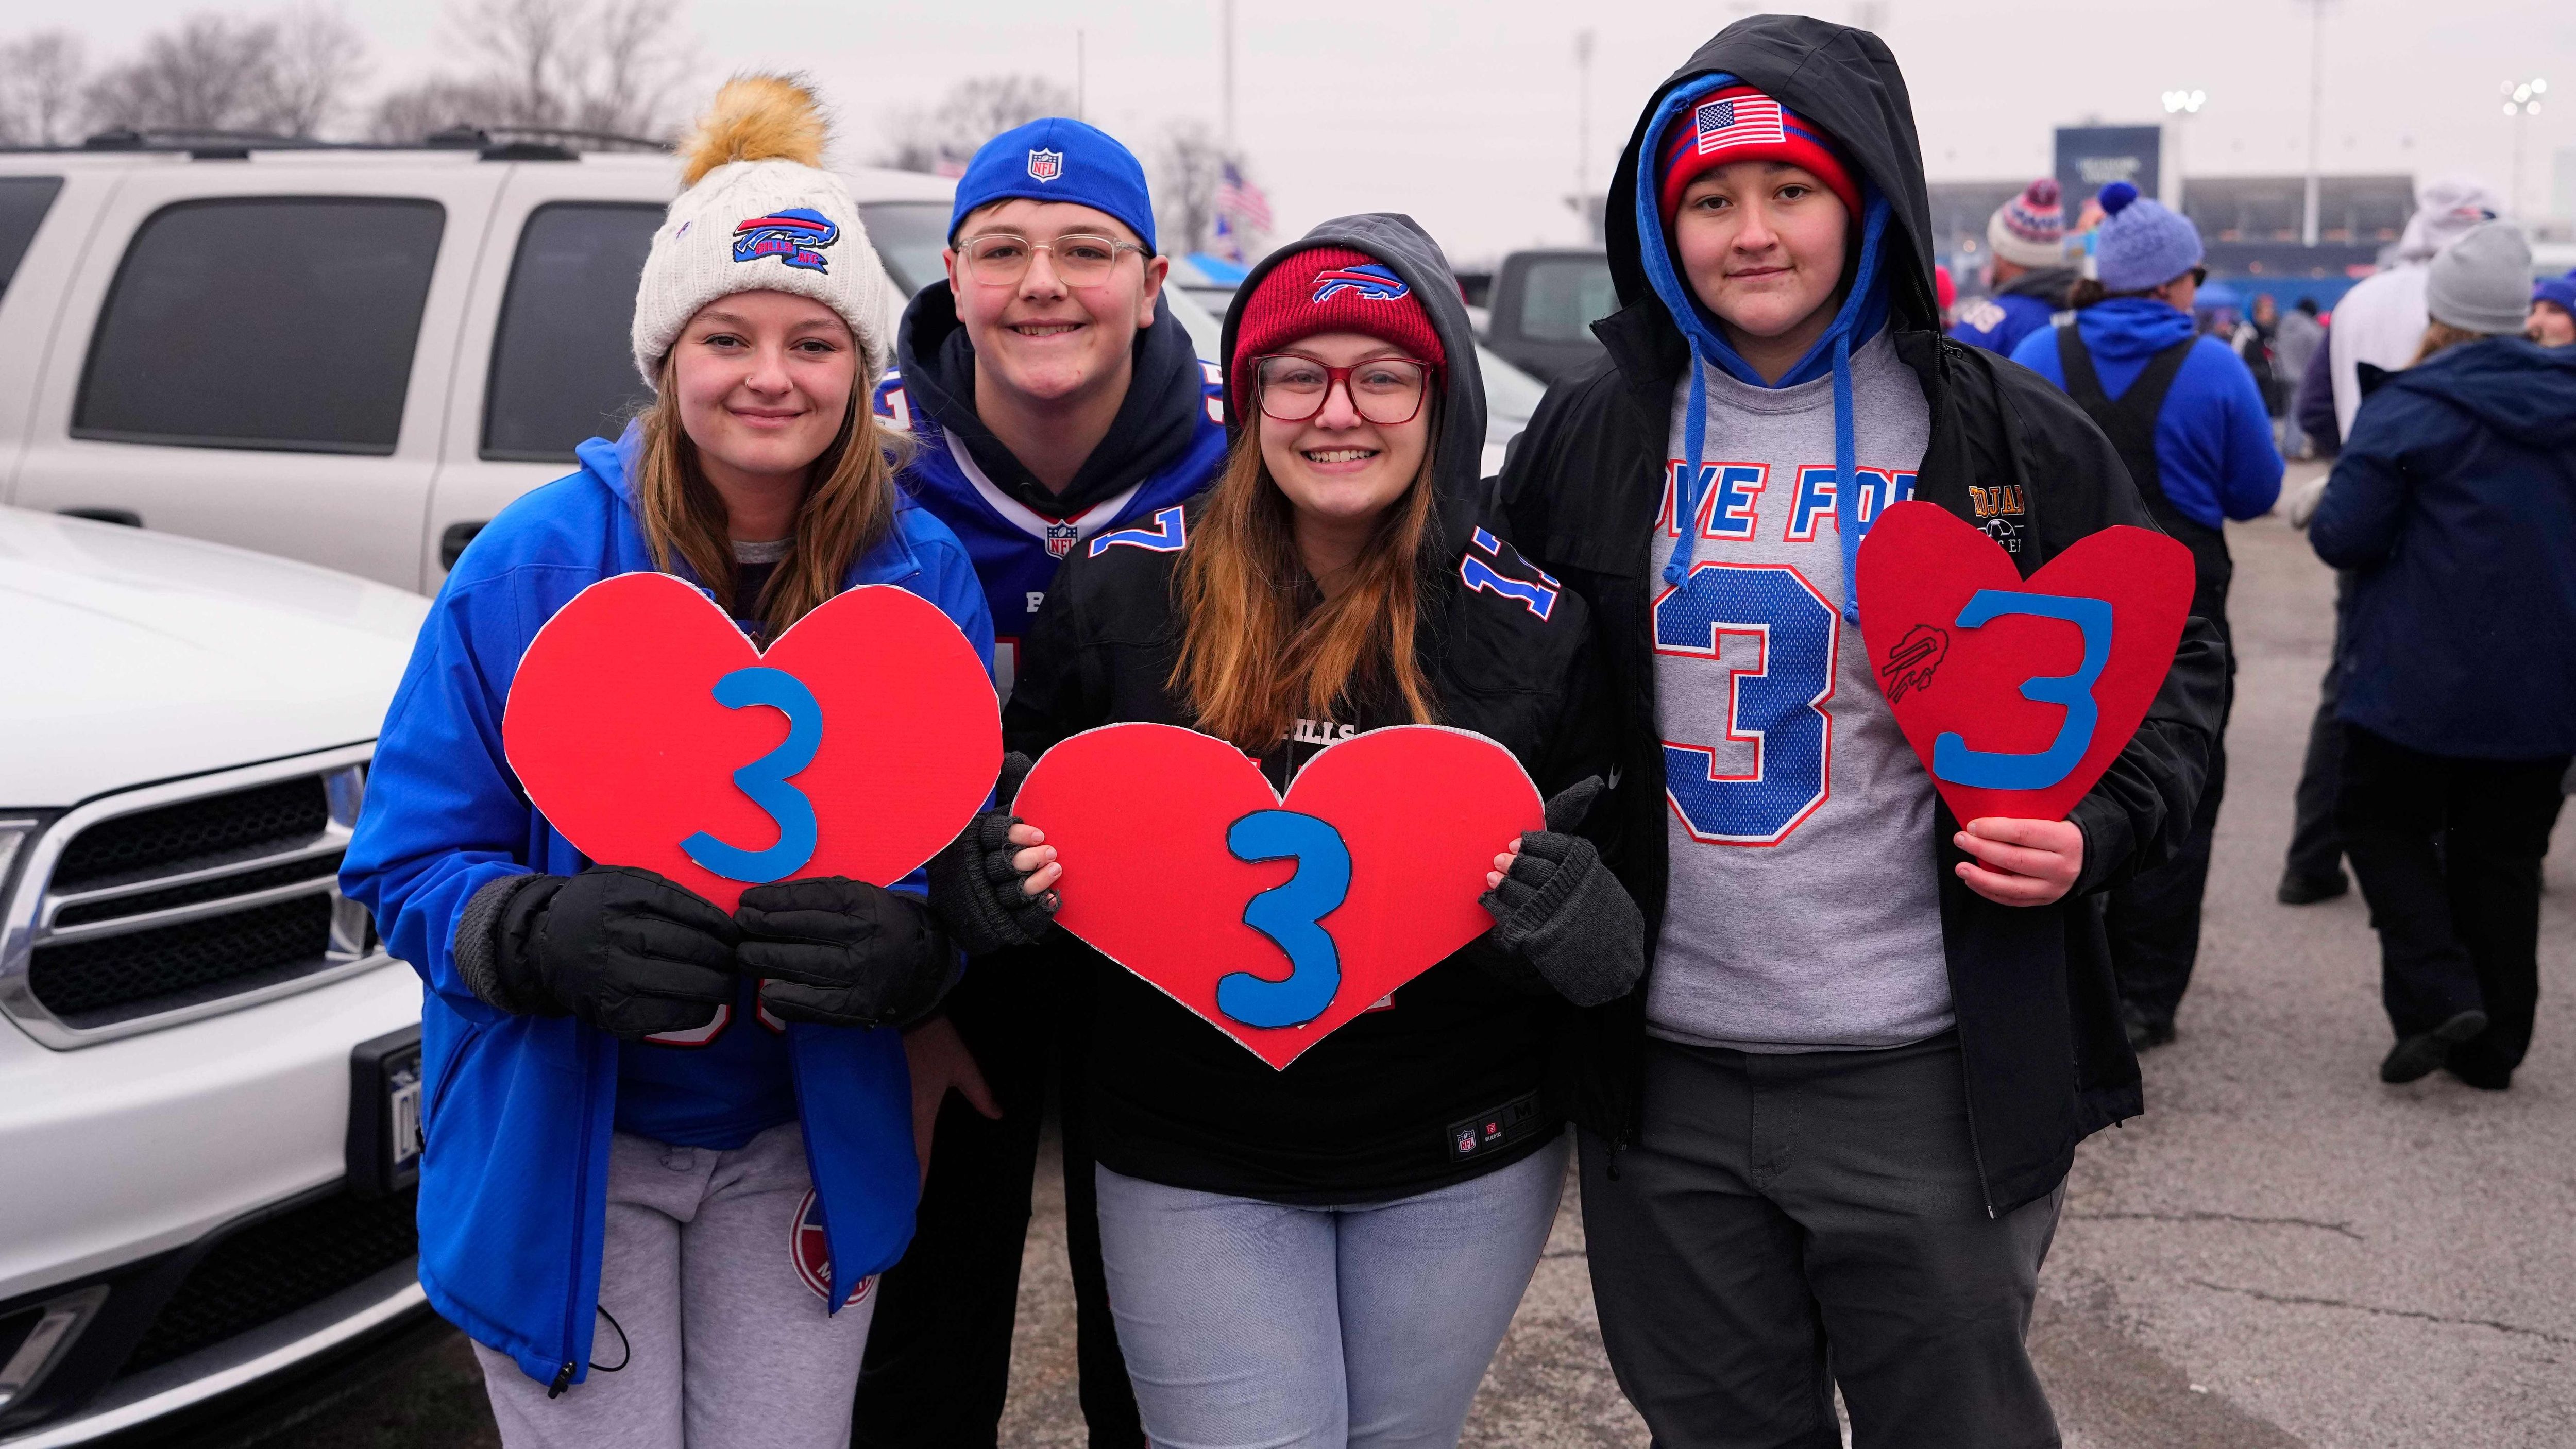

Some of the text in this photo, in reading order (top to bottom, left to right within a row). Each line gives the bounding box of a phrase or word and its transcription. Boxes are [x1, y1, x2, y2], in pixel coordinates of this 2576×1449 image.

[1033, 162, 1054, 176] NFL
[755, 241, 793, 254] BILLS
[798, 252, 819, 264] AFC
[1088, 504, 1187, 559] 7
[1653, 458, 1771, 542] VE
[1651, 561, 1841, 847] 3
[1934, 589, 2112, 790] 3
[680, 667, 823, 884] 3
[1217, 809, 1351, 1028] 3
[1461, 1138, 1474, 1150] NFL
